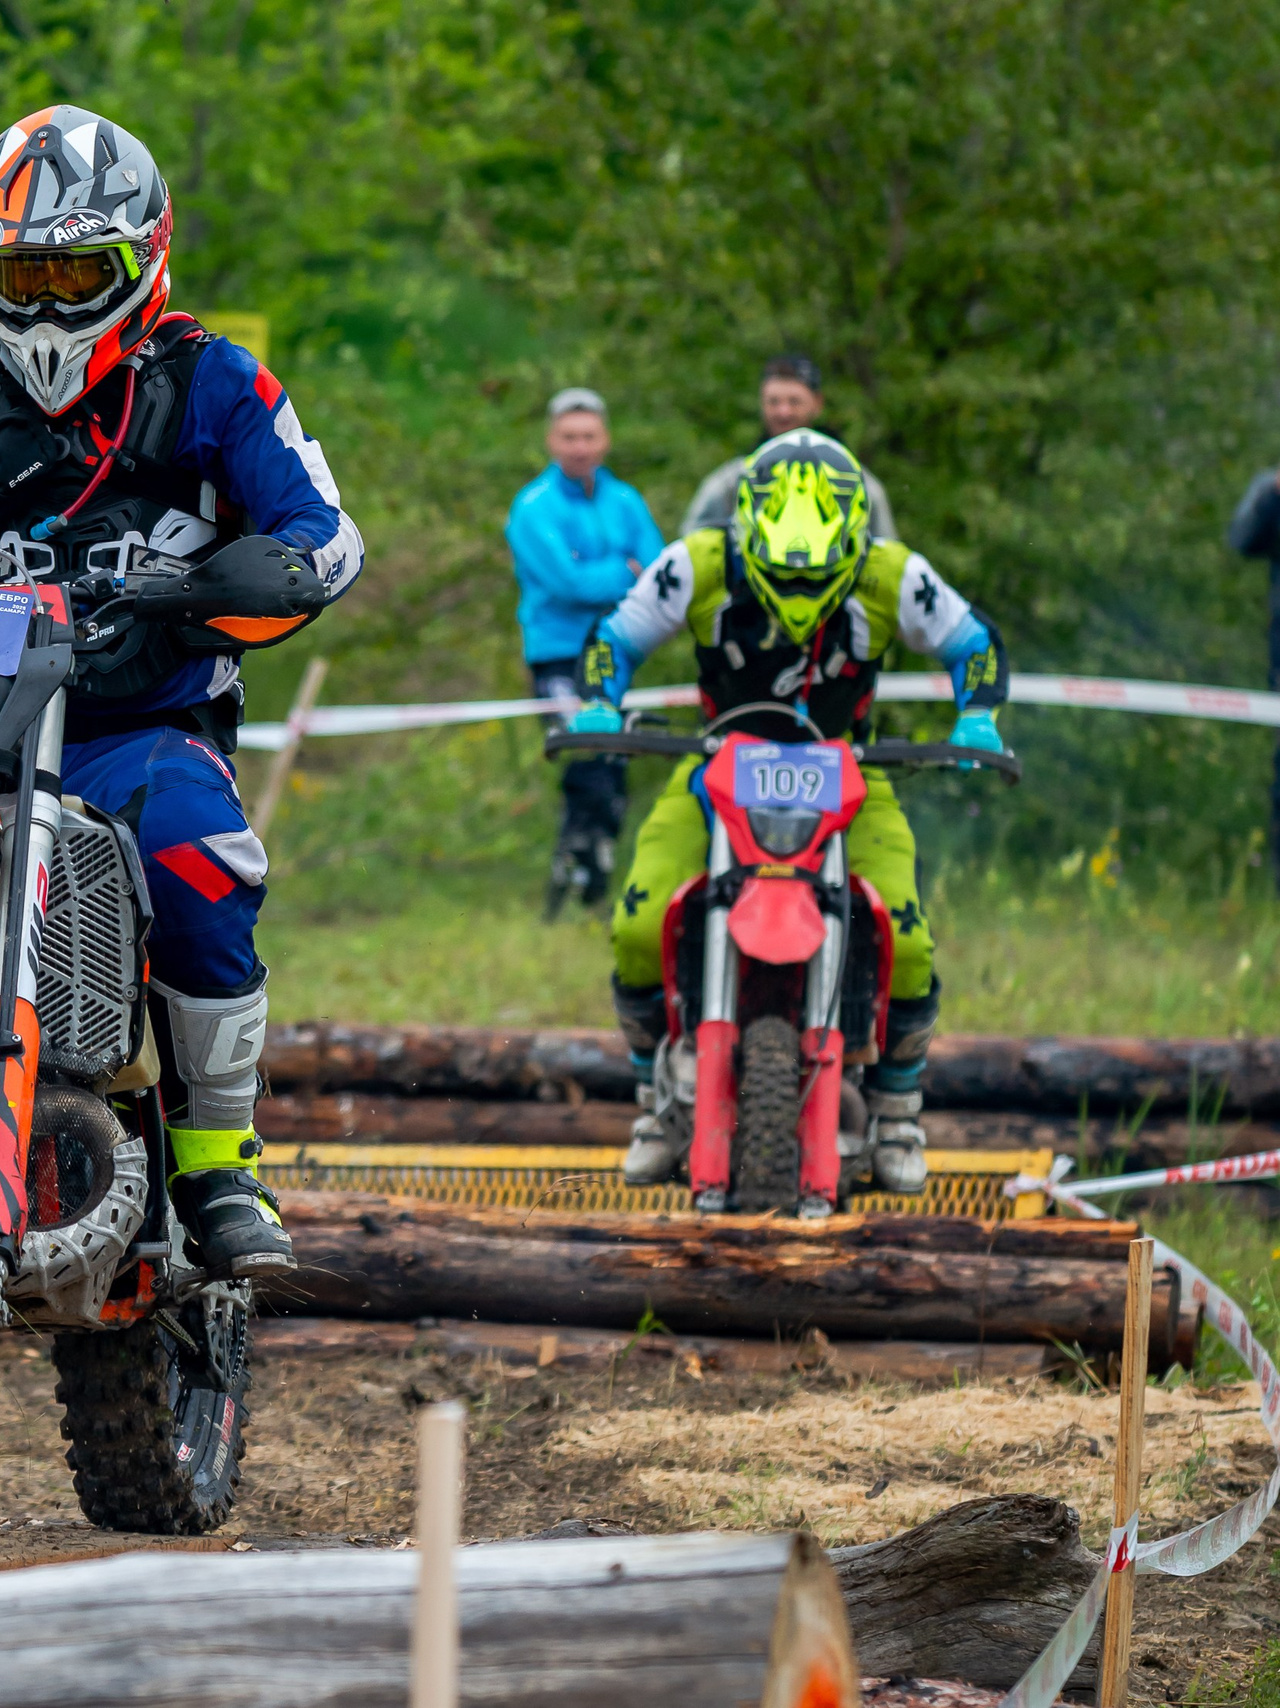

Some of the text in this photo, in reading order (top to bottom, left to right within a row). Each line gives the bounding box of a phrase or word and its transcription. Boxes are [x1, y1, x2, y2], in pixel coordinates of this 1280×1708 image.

[53, 213, 105, 245] Airoh
[8, 461, 43, 488] E-GEAR
[0, 607, 25, 615] САМАРА
[99, 625, 115, 638] PRO
[752, 761, 824, 803] 109
[1165, 1150, 1280, 1184] KENDA
